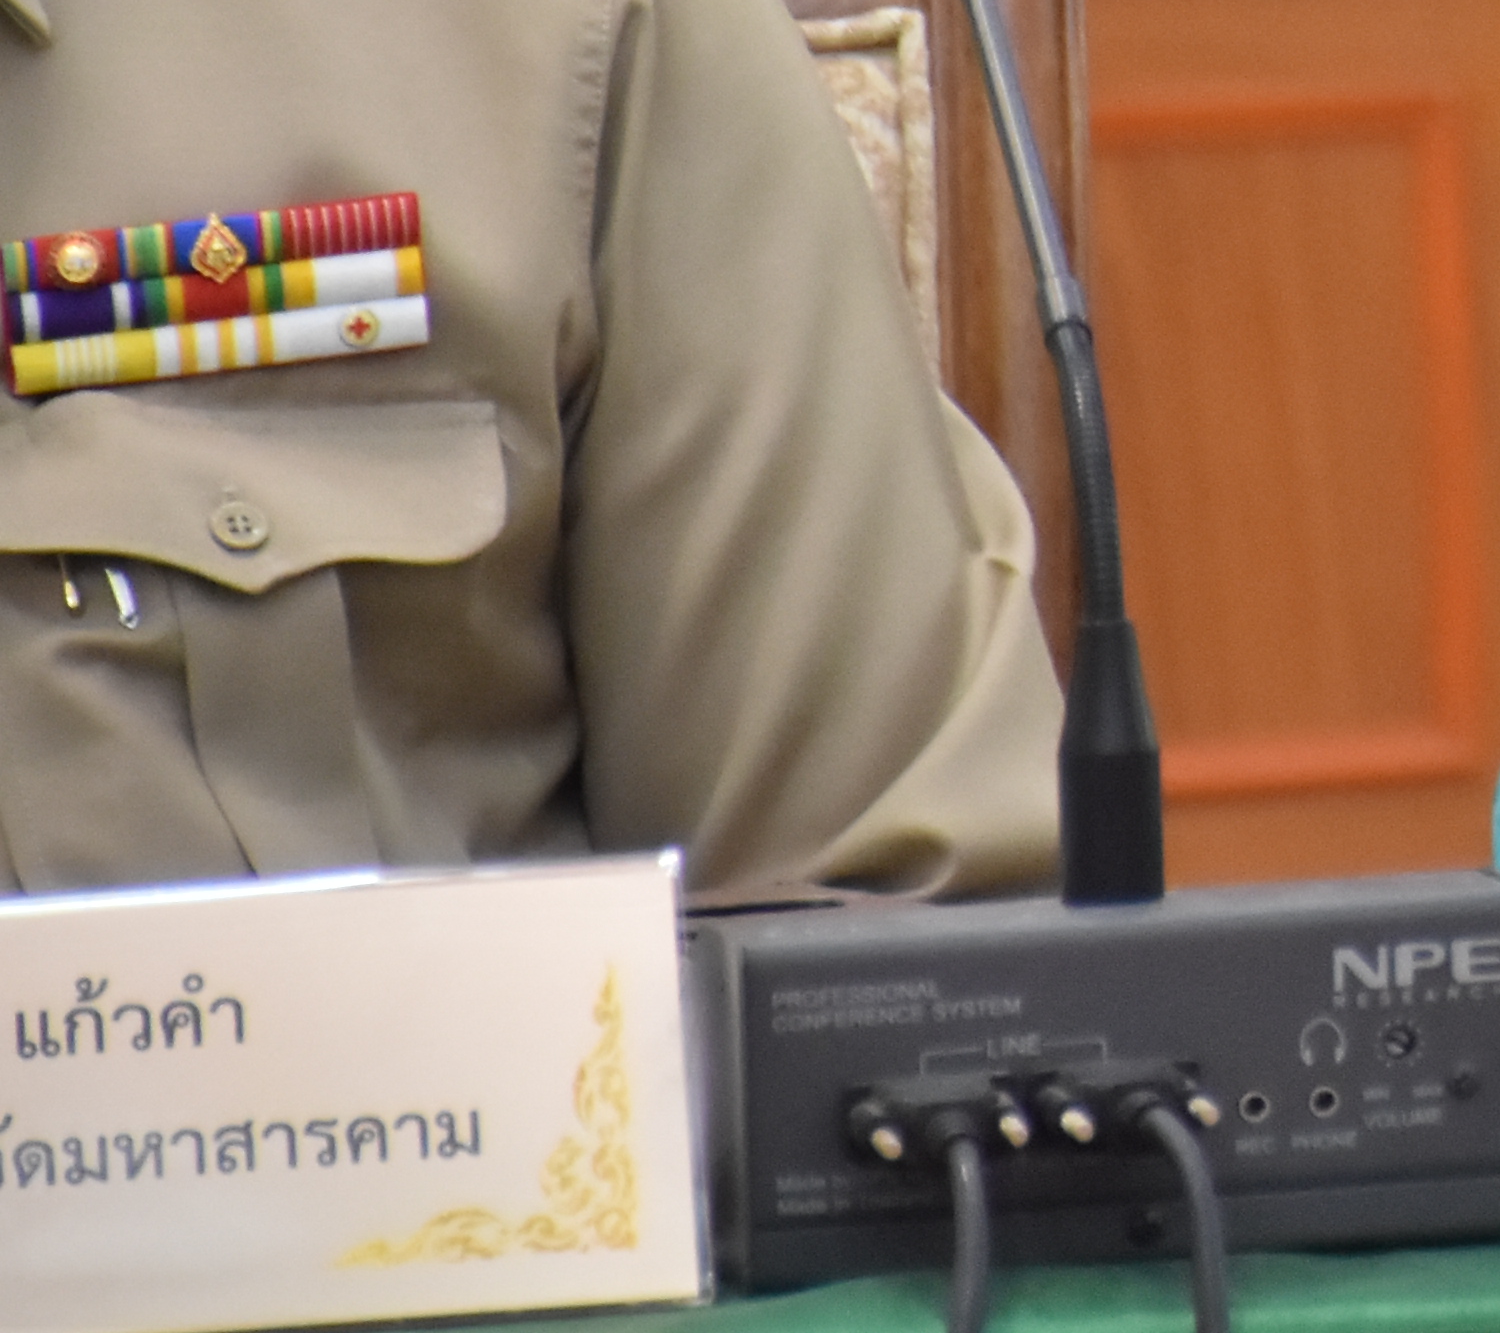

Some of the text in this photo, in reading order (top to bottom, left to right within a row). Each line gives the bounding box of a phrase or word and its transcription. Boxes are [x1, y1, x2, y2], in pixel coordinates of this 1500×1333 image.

[14, 972, 247, 1060] แก้วคำ
[932, 996, 1023, 1023] SYSTEM
[986, 1032, 1042, 1060] LINE
[0, 1107, 483, 1191] ดมหาสารคาม
